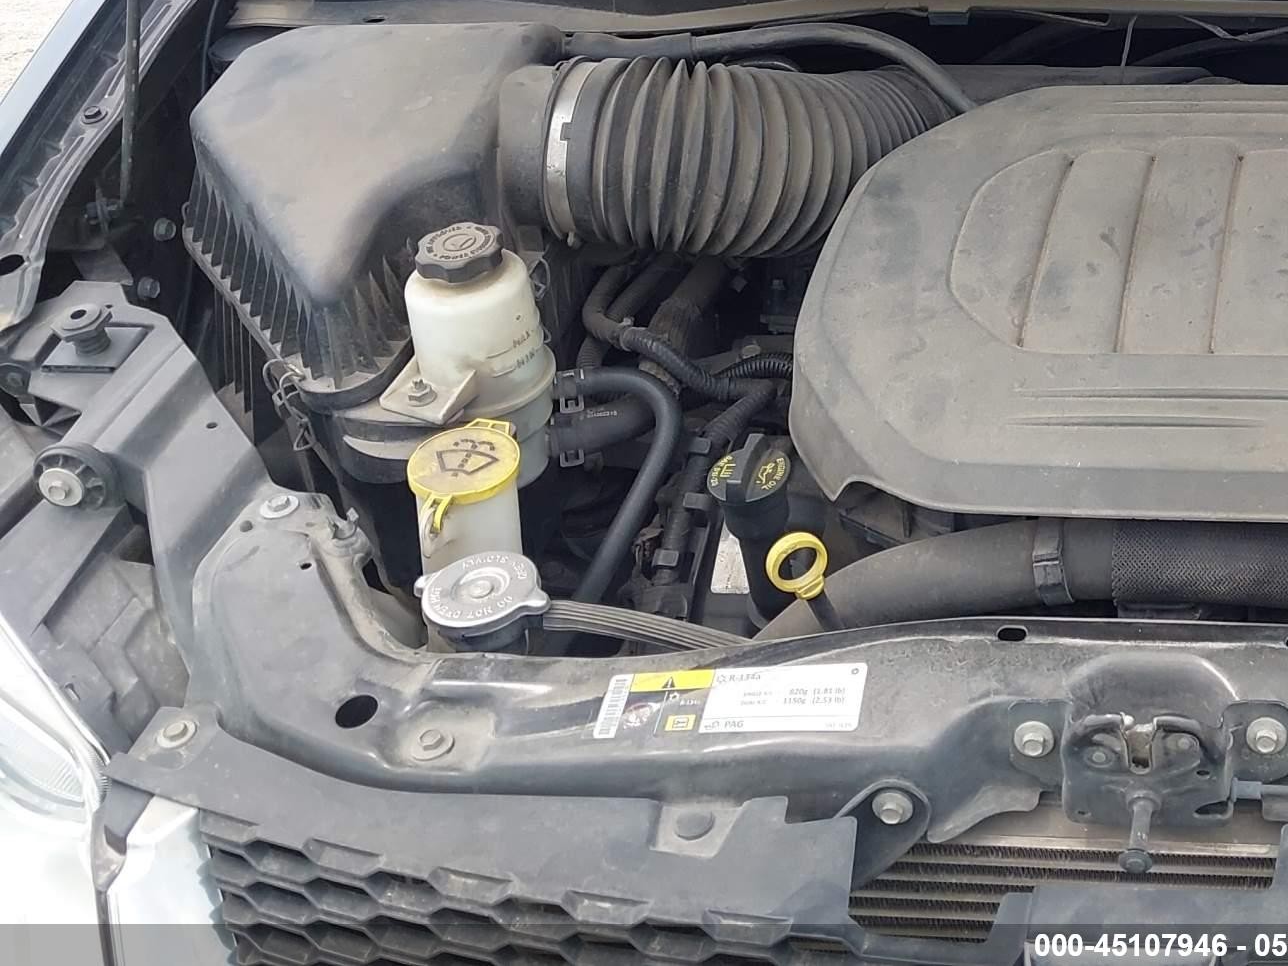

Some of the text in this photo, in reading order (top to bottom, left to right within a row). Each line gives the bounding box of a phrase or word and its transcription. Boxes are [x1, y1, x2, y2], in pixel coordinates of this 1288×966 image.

[761, 457, 786, 491] ENGINE OIL
[496, 595, 513, 609] DO
[466, 606, 494, 619] NOT
[724, 720, 745, 728] PAG
